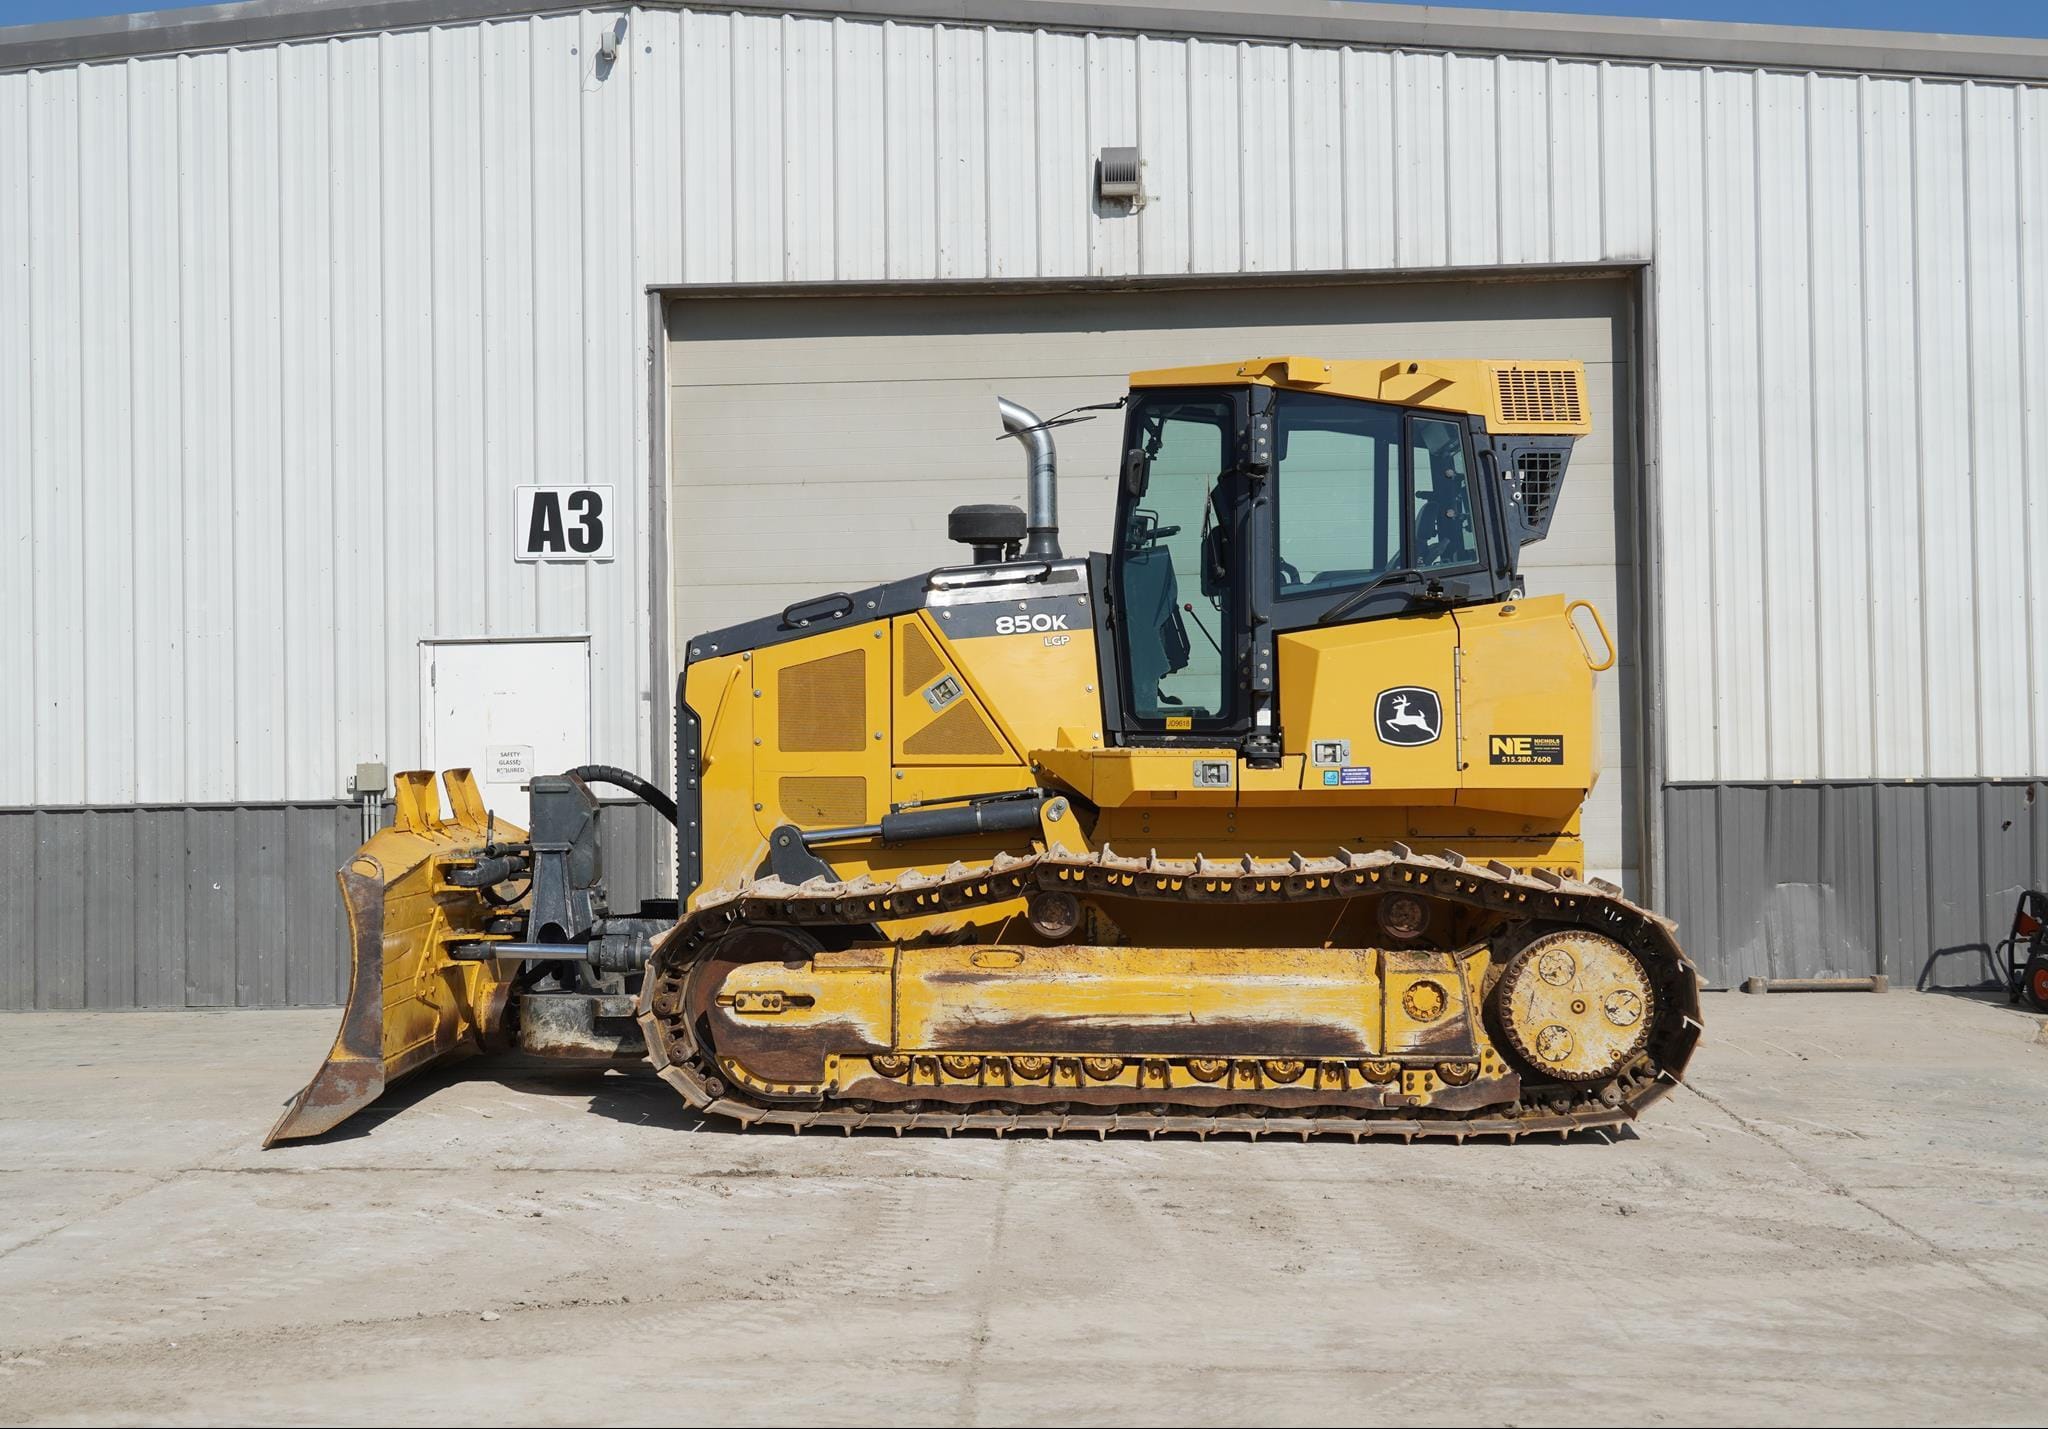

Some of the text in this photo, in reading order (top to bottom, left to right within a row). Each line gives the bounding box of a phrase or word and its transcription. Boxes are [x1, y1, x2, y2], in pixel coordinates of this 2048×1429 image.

[527, 490, 603, 553] A3
[995, 613, 1070, 635] 850K
[1044, 635, 1070, 646] LGP
[1492, 737, 1532, 755] NE
